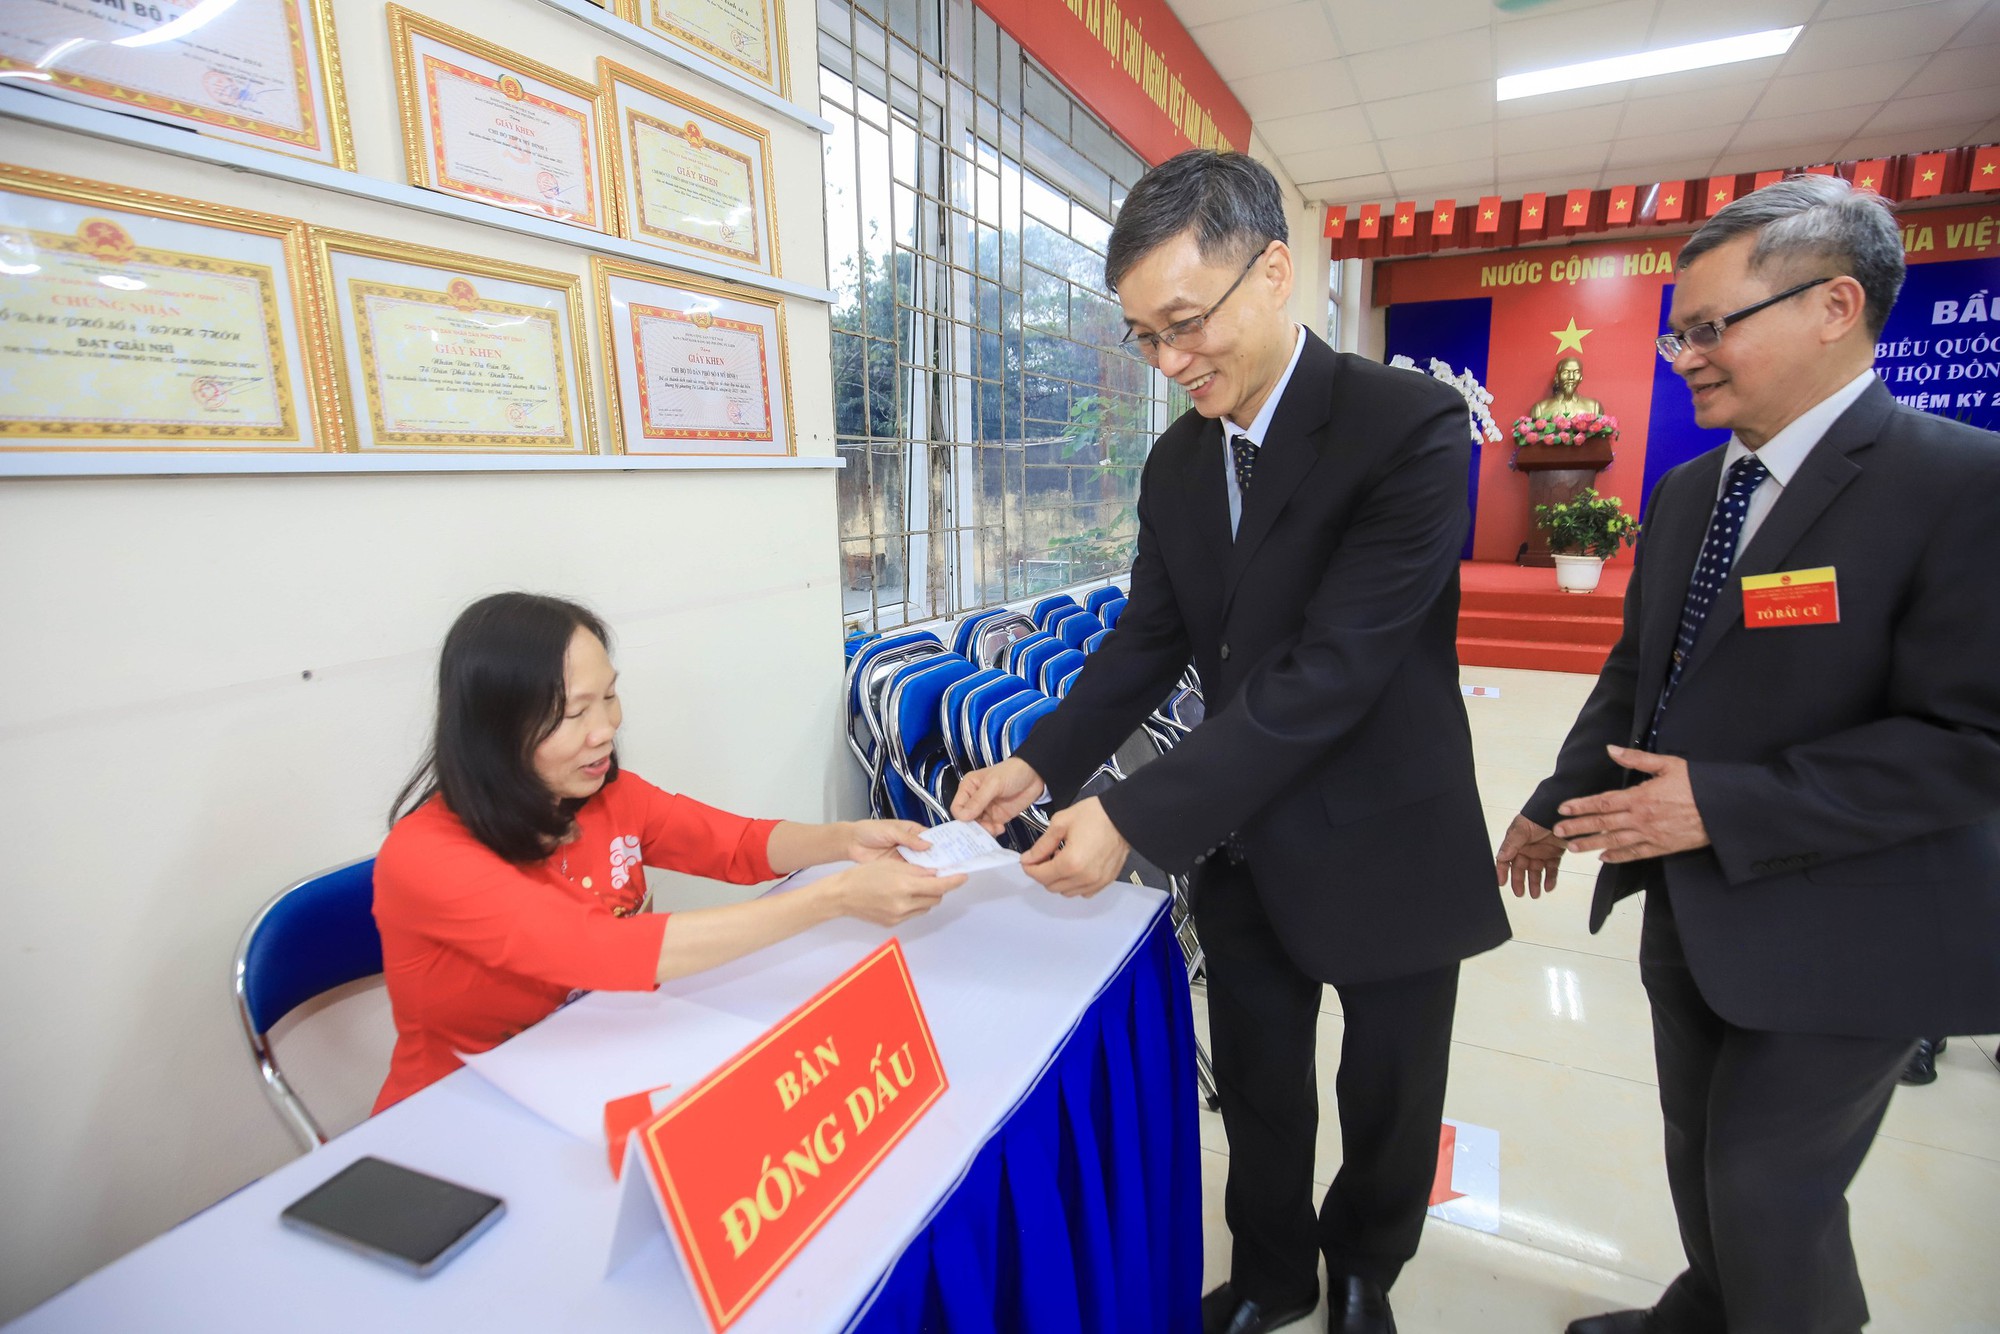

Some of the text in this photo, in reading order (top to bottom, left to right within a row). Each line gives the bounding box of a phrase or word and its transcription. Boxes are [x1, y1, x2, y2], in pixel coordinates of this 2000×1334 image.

[1103, 0, 1121, 69] HỘI
[1122, 16, 1142, 84] CHỦ
[1142, 42, 1168, 114] NGHĨA
[1168, 72, 1186, 136] VIỆT
[1184, 92, 1201, 148] NAM
[1481, 259, 1542, 287] NƯỚC
[1550, 255, 1616, 285] CỘNG
[1622, 248, 1672, 276] HÒA
[435, 342, 502, 358] GIẤY KHEN
[1875, 337, 1930, 358] BIỂU
[688, 352, 725, 366] GIẤY KHEN
[1895, 363, 1942, 385] HỘI
[1956, 390, 1986, 408] KỲ
[774, 1036, 841, 1112] BÀN
[720, 1042, 916, 1260] ĐÓNG DẤU
